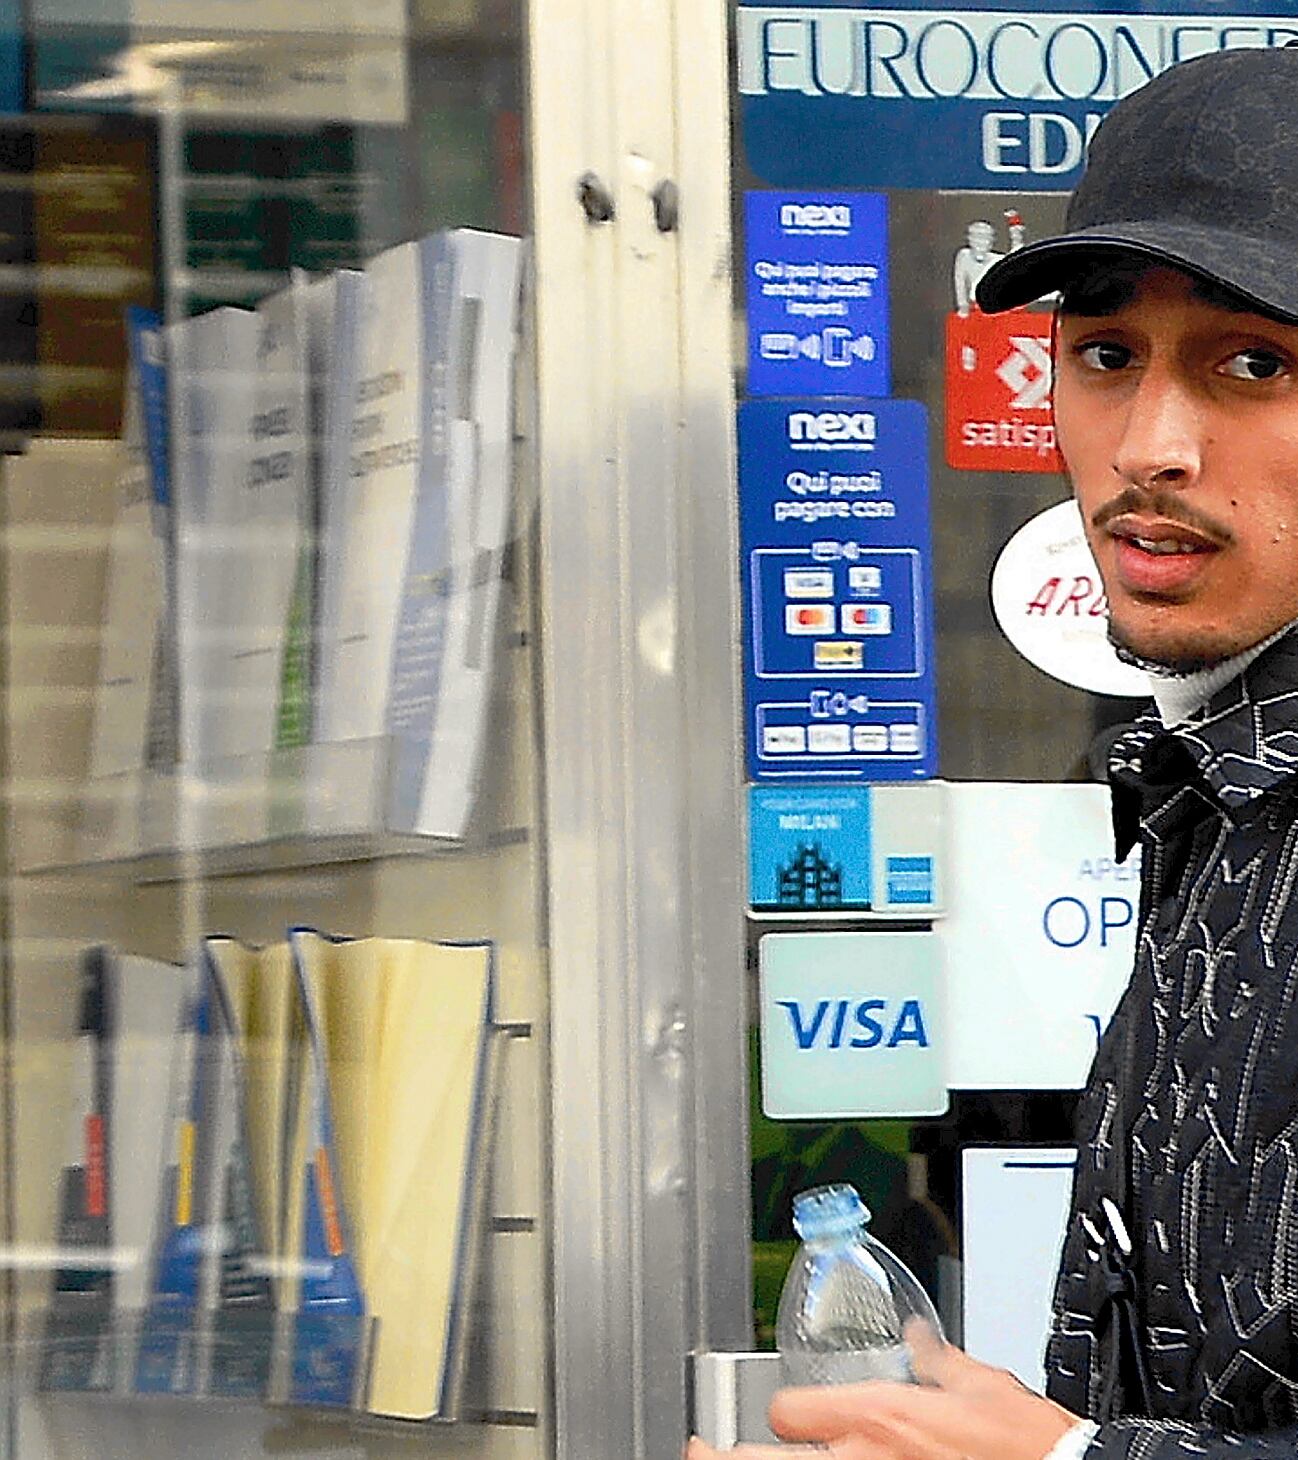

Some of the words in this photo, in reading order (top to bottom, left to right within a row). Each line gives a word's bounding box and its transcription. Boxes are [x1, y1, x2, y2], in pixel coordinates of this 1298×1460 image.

[789, 412, 876, 440] nexi
[786, 471, 829, 495] Qui
[830, 471, 881, 495] puoi
[775, 501, 850, 522] pagare
[851, 501, 896, 517] con
[1043, 896, 1134, 949] OP
[775, 1000, 930, 1050] VISA
